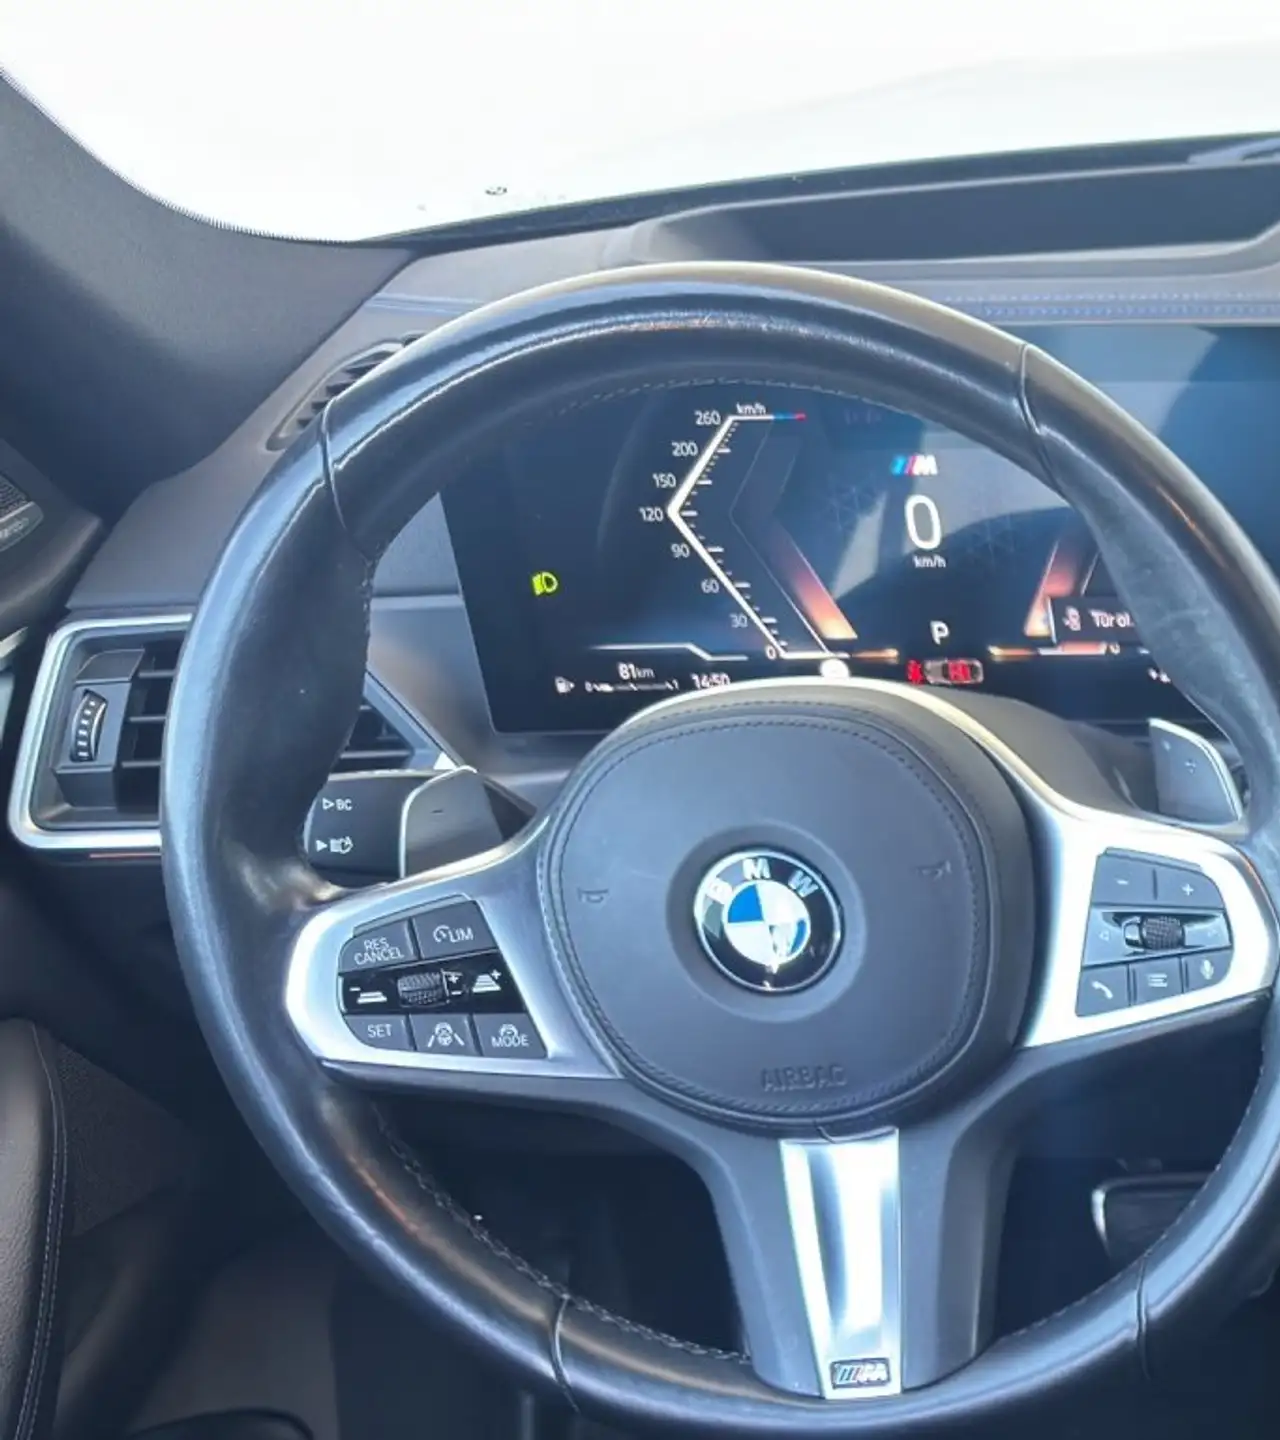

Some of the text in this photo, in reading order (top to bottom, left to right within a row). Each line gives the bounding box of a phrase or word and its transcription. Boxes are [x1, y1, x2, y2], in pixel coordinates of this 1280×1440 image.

[736, 402, 767, 415] km/h
[695, 410, 721, 426] 260
[671, 442, 698, 457] 200
[652, 473, 676, 488] 150
[639, 507, 663, 522] 120
[905, 494, 942, 550] 0
[671, 543, 689, 558] 90
[913, 555, 947, 569] km/h
[701, 578, 719, 594] 60
[729, 613, 748, 628] 30
[930, 620, 950, 645] P
[766, 646, 776, 660] 0
[706, 857, 819, 905] BMW
[450, 927, 473, 942] LIM
[363, 937, 388, 951] RES
[354, 946, 405, 965] CANCEL
[367, 1026, 392, 1039] SET
[492, 1034, 529, 1048] MODE
[761, 1063, 848, 1093] AIRBAG
